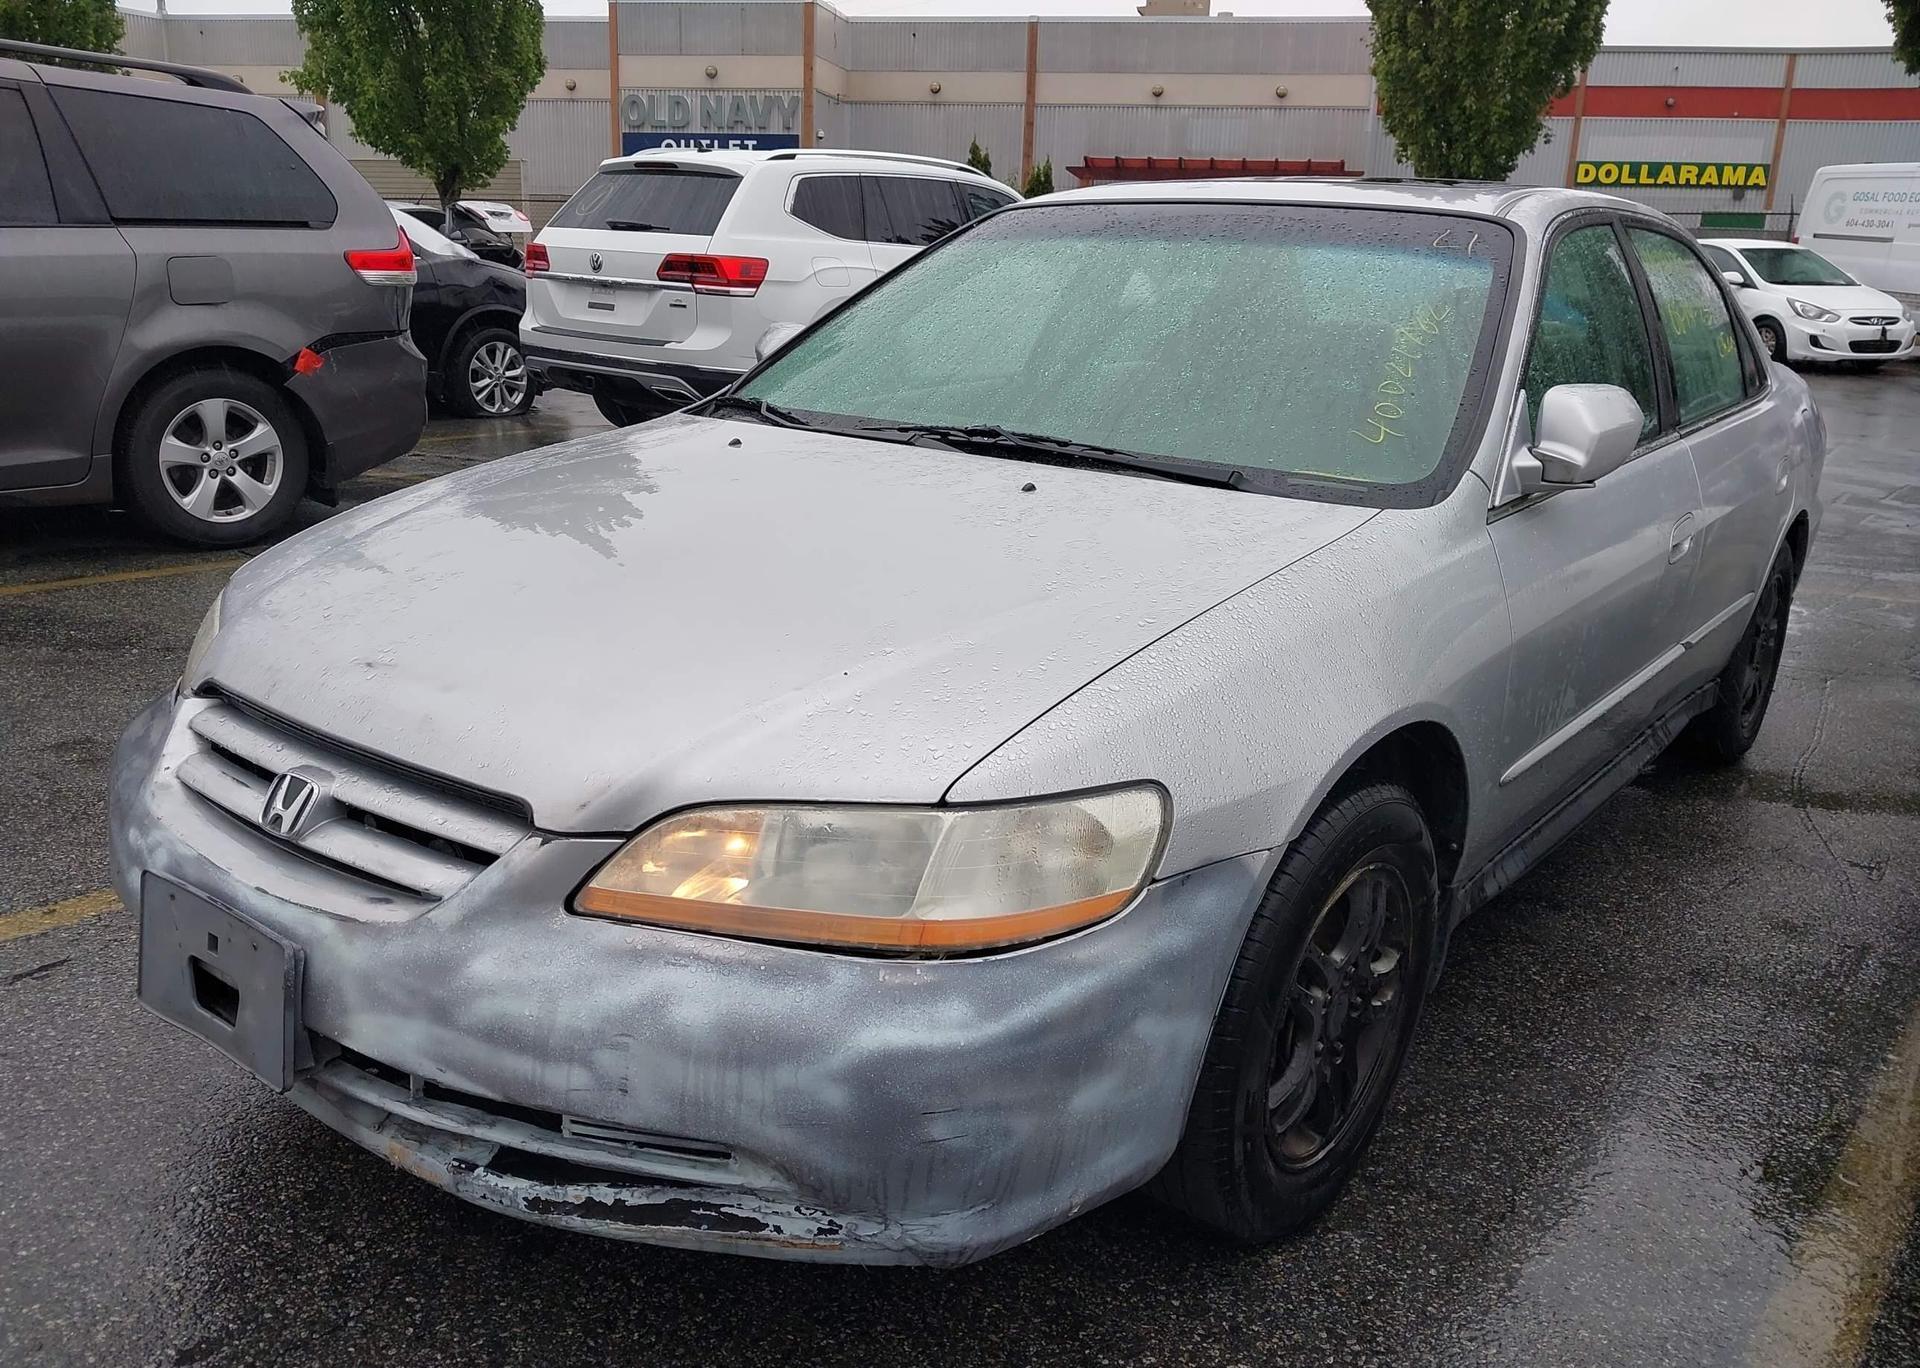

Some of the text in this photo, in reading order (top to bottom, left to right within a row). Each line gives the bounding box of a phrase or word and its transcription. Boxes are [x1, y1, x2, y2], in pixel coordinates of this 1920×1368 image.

[621, 94, 800, 130] OLD NAVY
[1576, 164, 1767, 186] DOLLARAMA
[1853, 191, 1880, 202] GOSAL
[1882, 192, 1907, 203] FOOD
[1845, 218, 1895, 229] 604-430-3041
